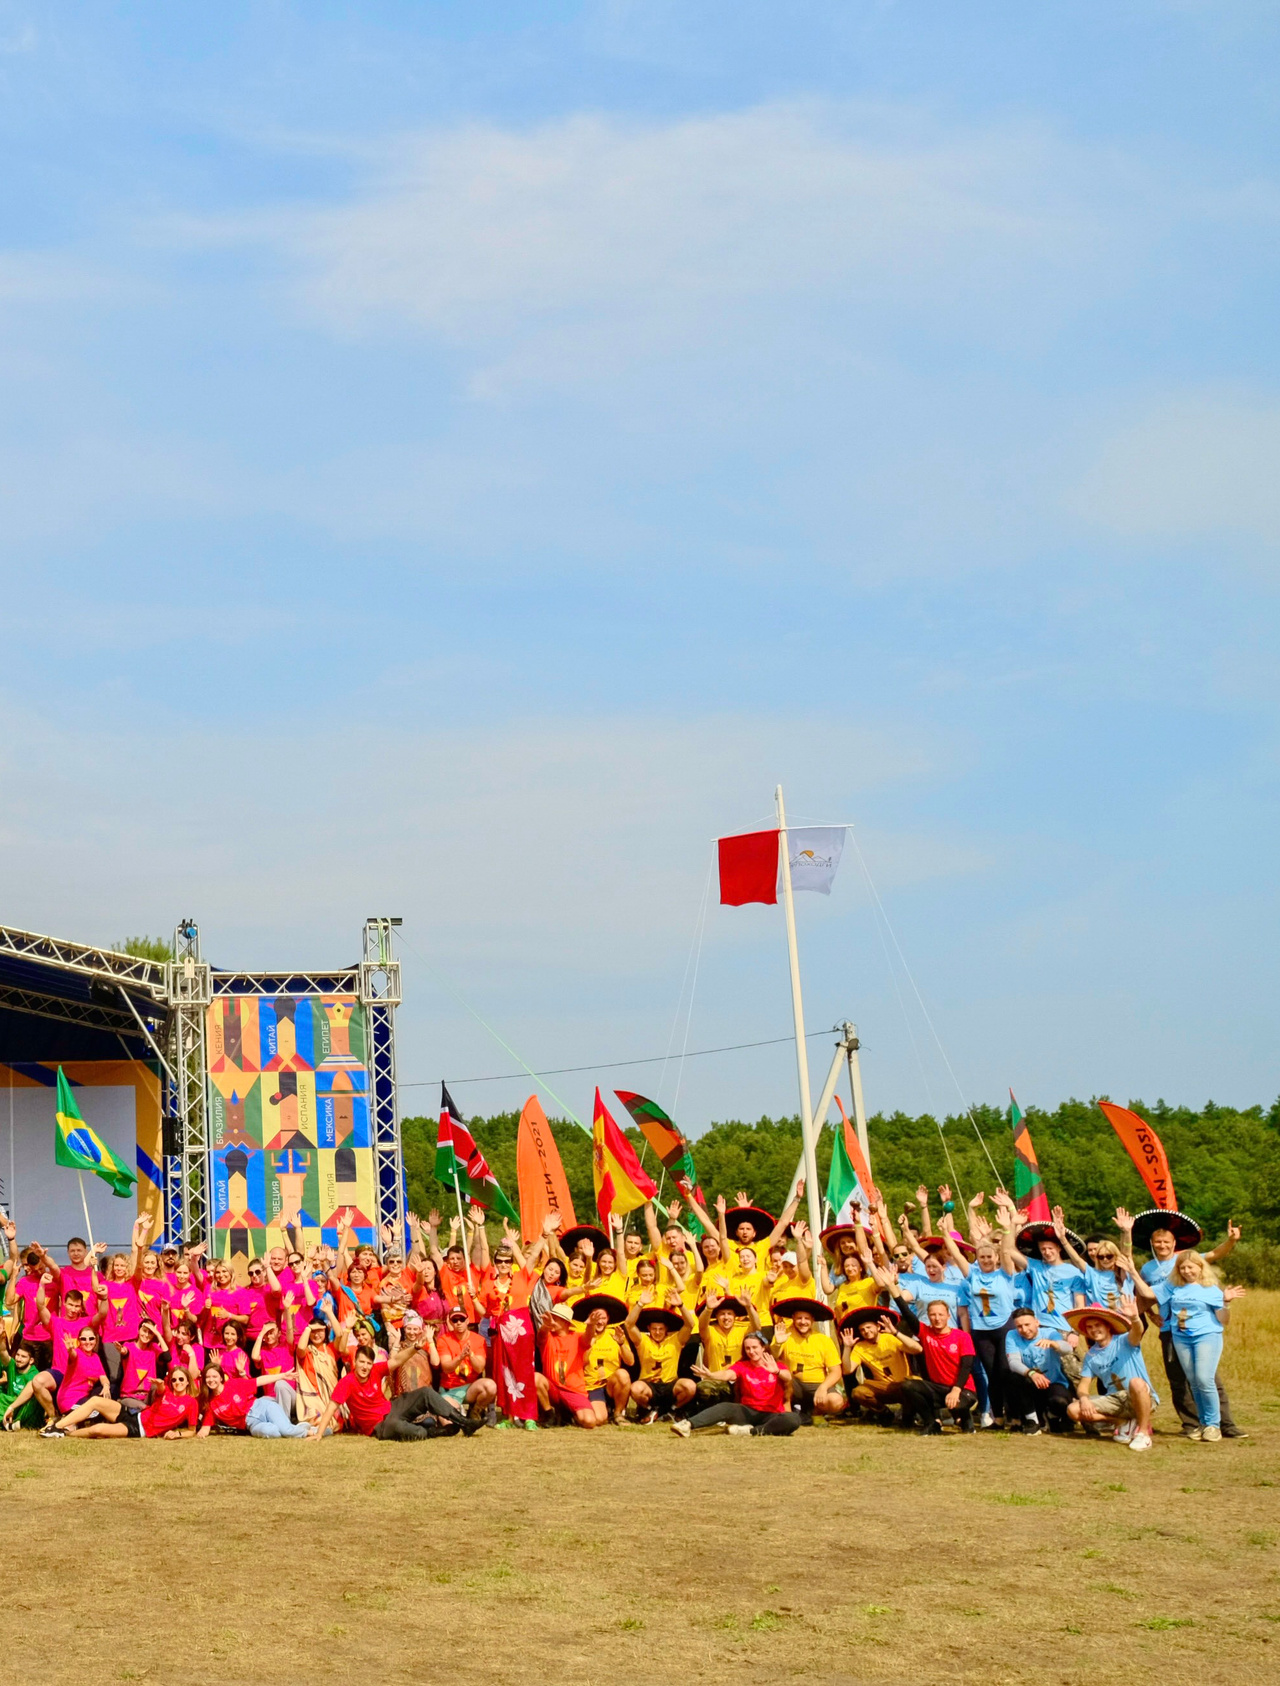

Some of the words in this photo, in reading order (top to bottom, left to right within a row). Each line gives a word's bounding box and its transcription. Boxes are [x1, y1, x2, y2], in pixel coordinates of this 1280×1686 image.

[268, 1024, 276, 1055] КИТАЙ
[216, 1096, 224, 1144] БРАЗИЛИЯ
[325, 1098, 333, 1142] МЕКСИКА
[531, 1121, 547, 1158] 2021
[272, 1181, 281, 1221] ШВЕЦИЯ
